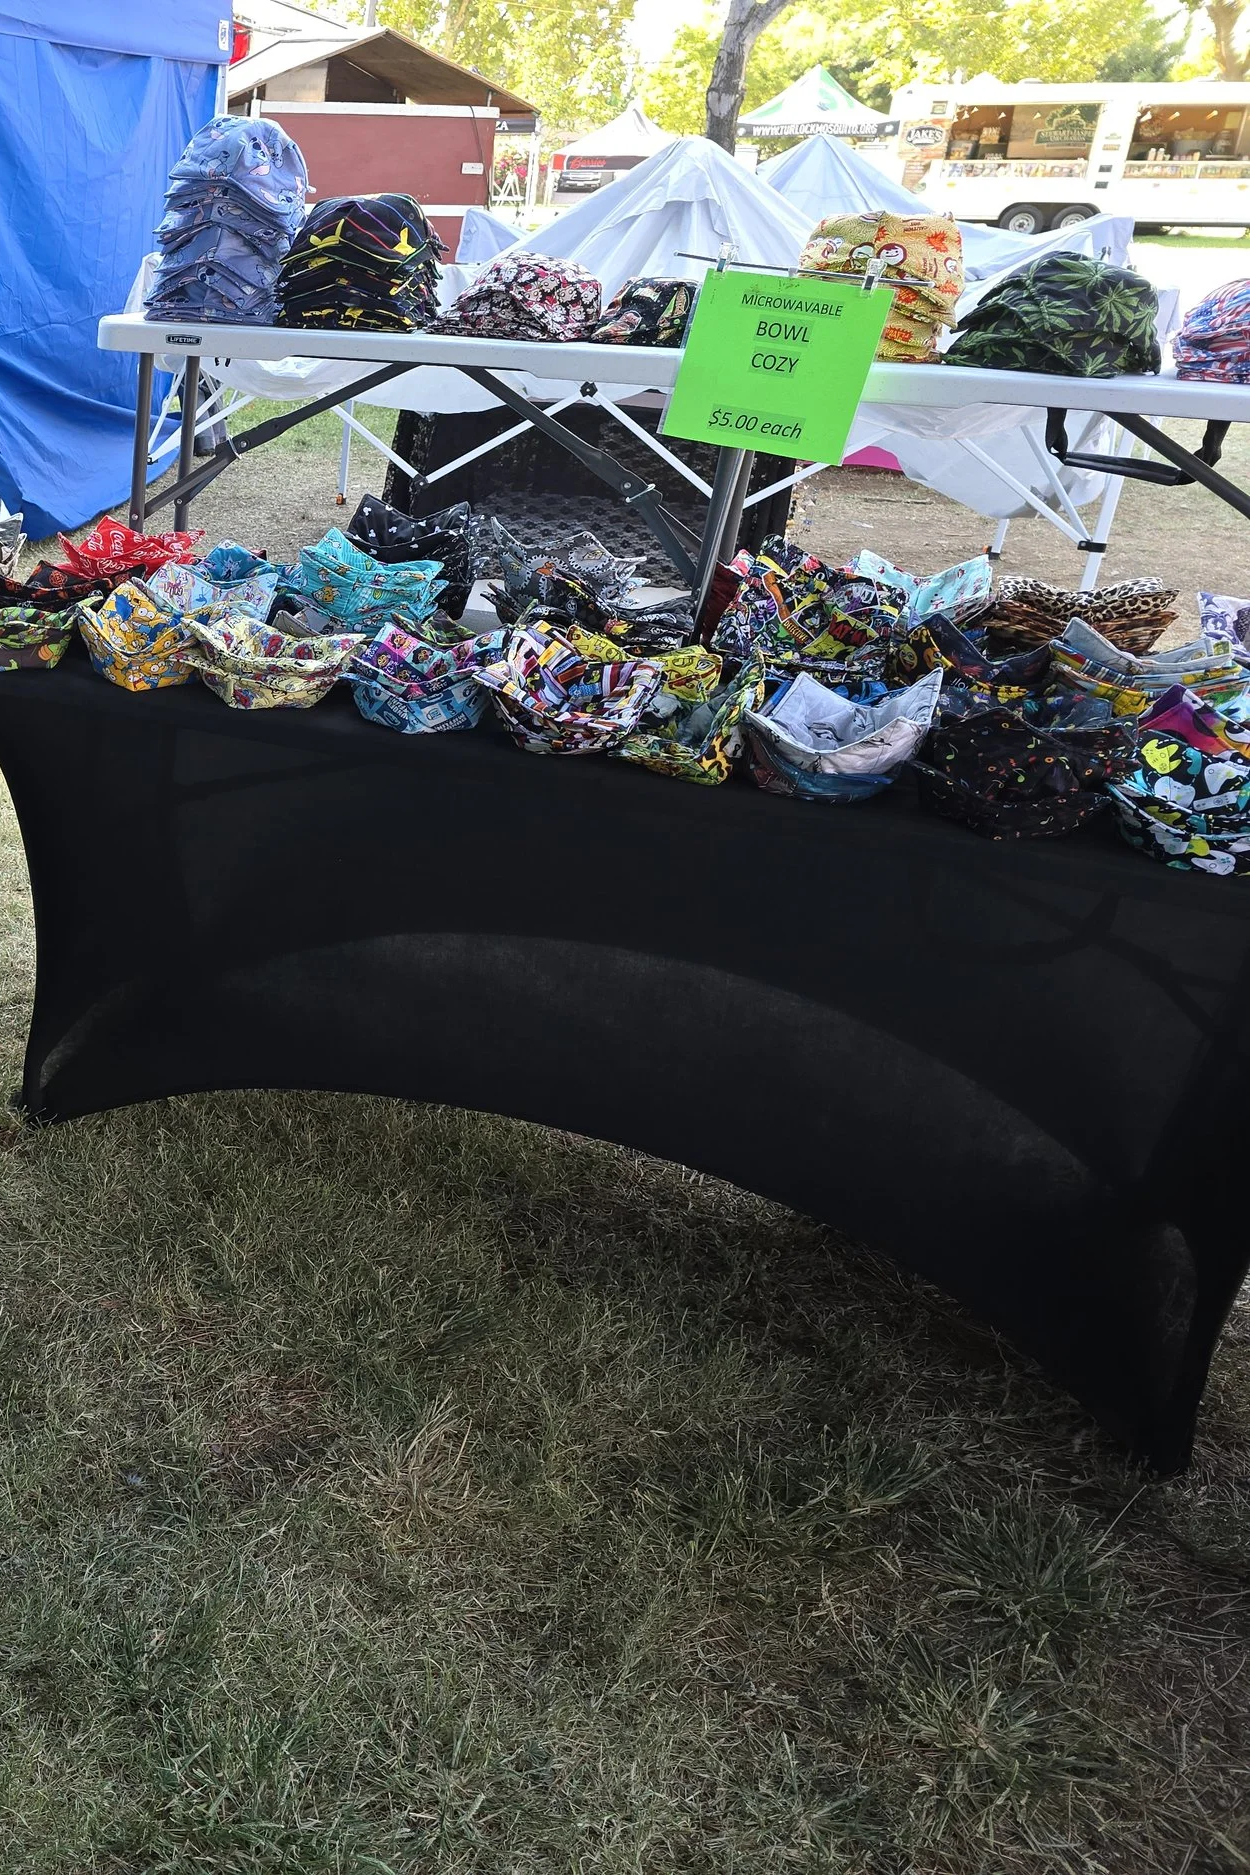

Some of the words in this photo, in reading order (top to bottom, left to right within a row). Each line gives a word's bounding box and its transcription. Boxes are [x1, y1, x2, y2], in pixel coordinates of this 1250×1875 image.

[752, 123, 878, 137] WWW.TURLOCKMOSQUITO.ORG
[907, 128, 944, 143] JAKE'S
[741, 294, 844, 317] MICROWAVABLE
[169, 336, 199, 344] LIFETIME
[756, 321, 811, 343] BOWL
[751, 353, 799, 373] COZY
[708, 409, 758, 431] $5.00
[760, 422, 802, 439] each
[783, 620, 808, 644] DETECTIVE
